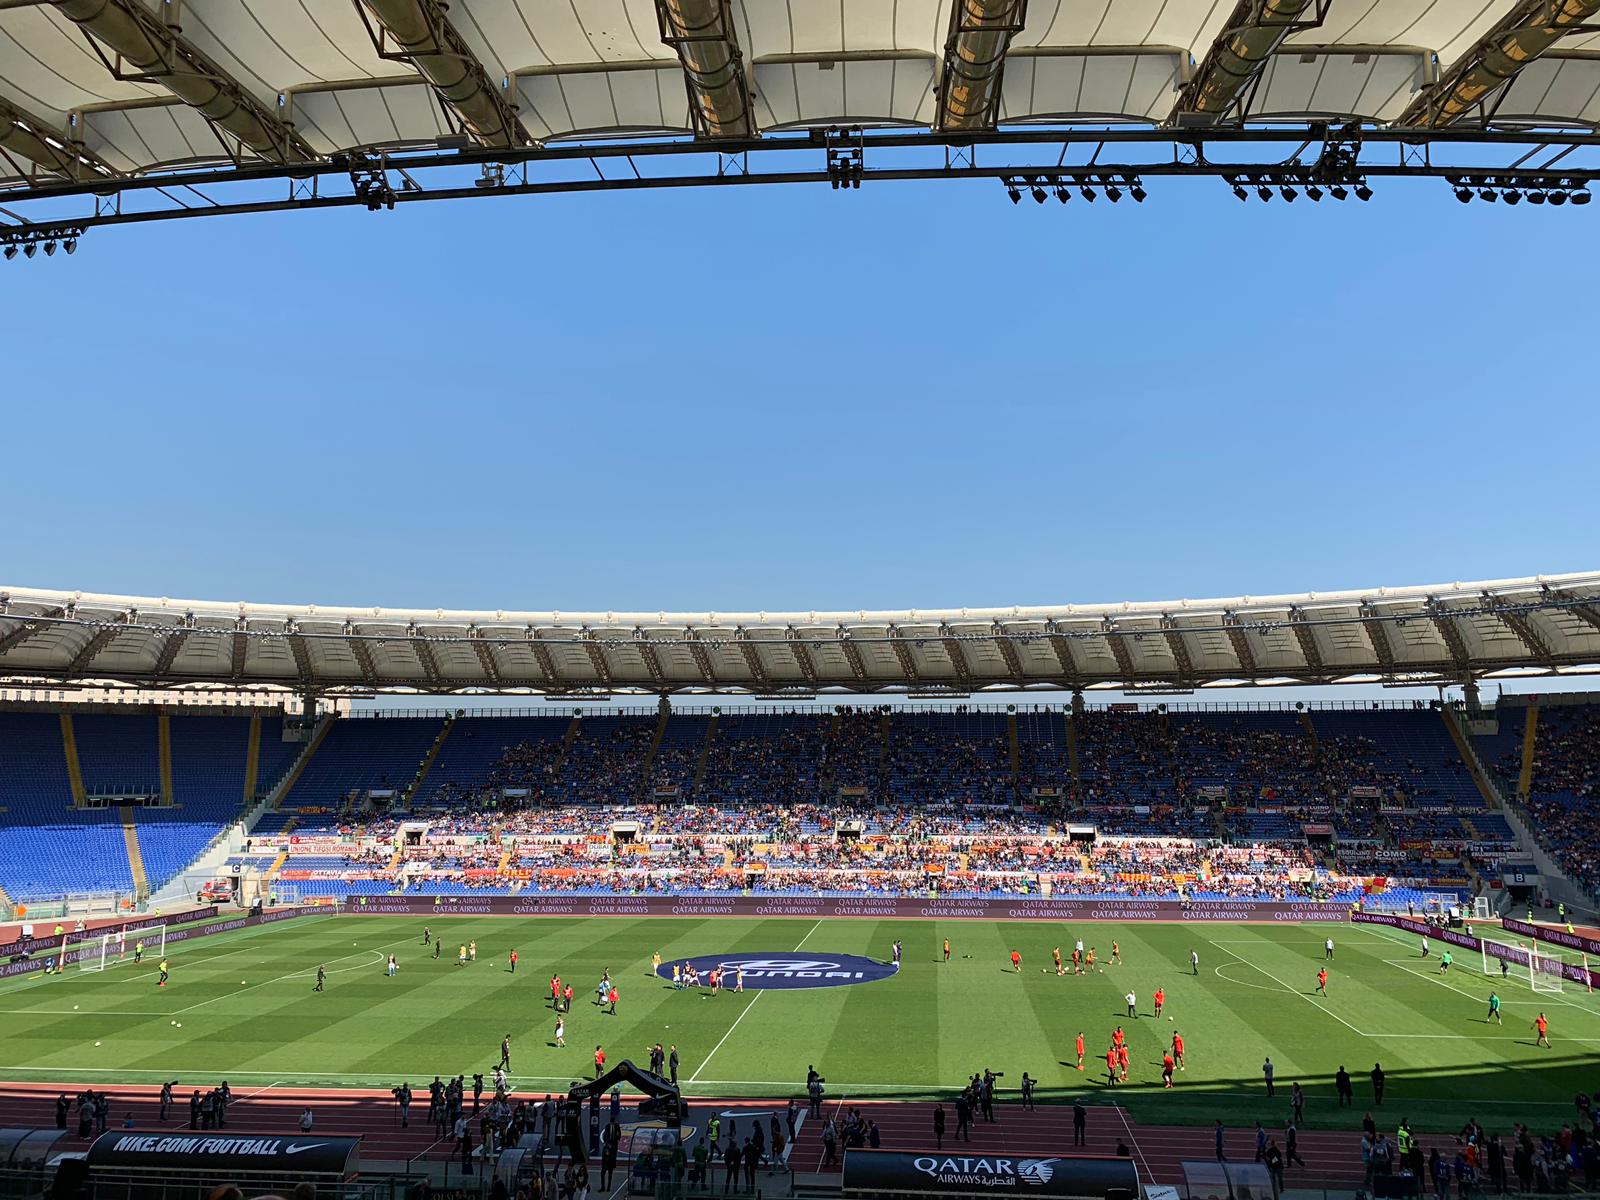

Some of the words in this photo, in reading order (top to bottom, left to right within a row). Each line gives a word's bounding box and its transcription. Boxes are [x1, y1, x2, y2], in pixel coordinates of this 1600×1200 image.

[1375, 850, 1407, 858] COMO
[1516, 874, 1524, 882] B
[767, 898, 792, 906] QATAR
[930, 900, 955, 908] QATAR
[1023, 901, 1049, 909] QATAR
[1098, 902, 1124, 910] QATAR
[757, 907, 783, 915] QATAR
[835, 907, 861, 915] QATAR
[1194, 903, 1220, 911] QATAR
[1291, 903, 1317, 911] QATAR
[921, 908, 948, 916] QATAR
[949, 908, 983, 916] AIRWAYS
[1009, 910, 1037, 918] QATAR
[1092, 911, 1119, 919] QATAR
[1183, 912, 1210, 920] QATAR
[1275, 912, 1303, 920] QATAR
[1304, 912, 1341, 920] AIRWAYS
[1371, 915, 1396, 924] AIRWAYS
[205, 925, 223, 934] QATAR
[224, 920, 246, 931] AIRWAYS
[1401, 920, 1414, 928] QATAR
[1443, 931, 1457, 941] QATAR
[1458, 935, 1476, 947] AIRWAYS
[1544, 930, 1560, 939] QATAR
[1560, 933, 1582, 945] AIRWAYS
[6, 958, 41, 973] AIRWAYS
[113, 1136, 281, 1155] NIKE.COM/FOOTBALL
[913, 1157, 1014, 1177] QATAR
[937, 1175, 981, 1185] AIRWAYS
[981, 1175, 1016, 1187] القطرية
